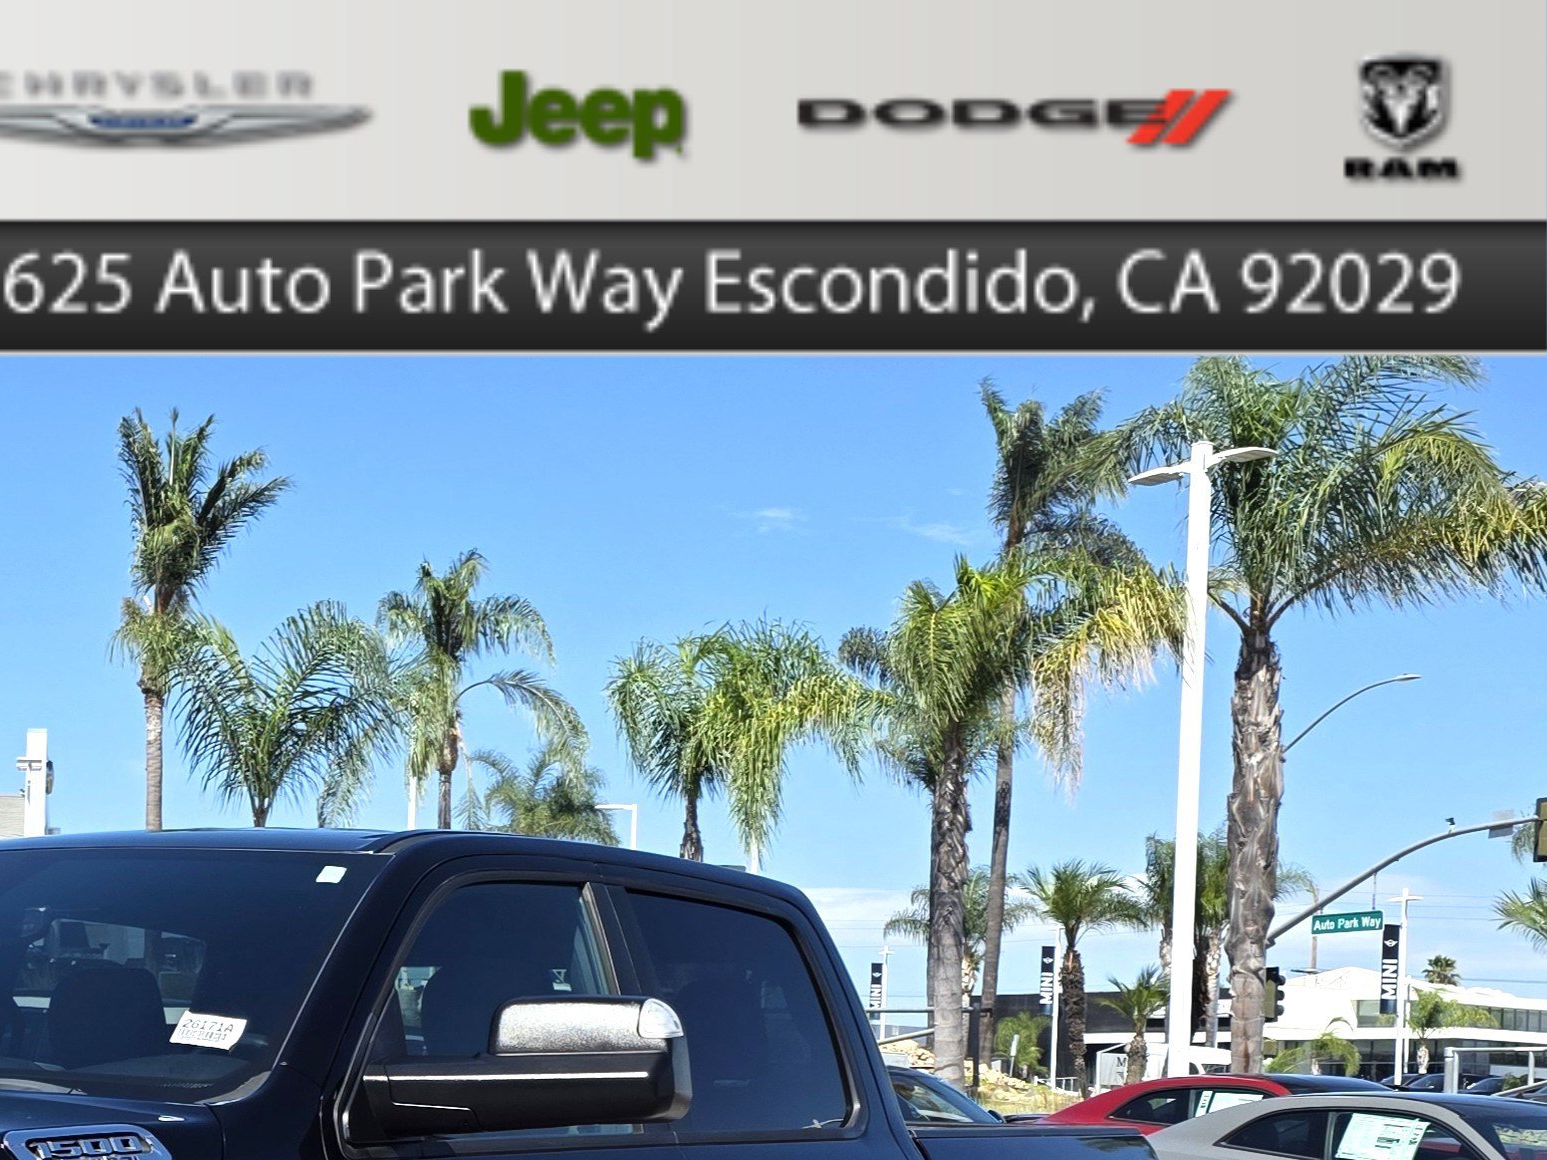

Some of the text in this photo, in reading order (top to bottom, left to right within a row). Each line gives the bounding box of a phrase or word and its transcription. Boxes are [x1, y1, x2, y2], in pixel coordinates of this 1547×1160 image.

[1313, 916, 1382, 931] Auto Park Way
[1039, 971, 1054, 1005] MINI
[1381, 958, 1398, 1000] MINI
